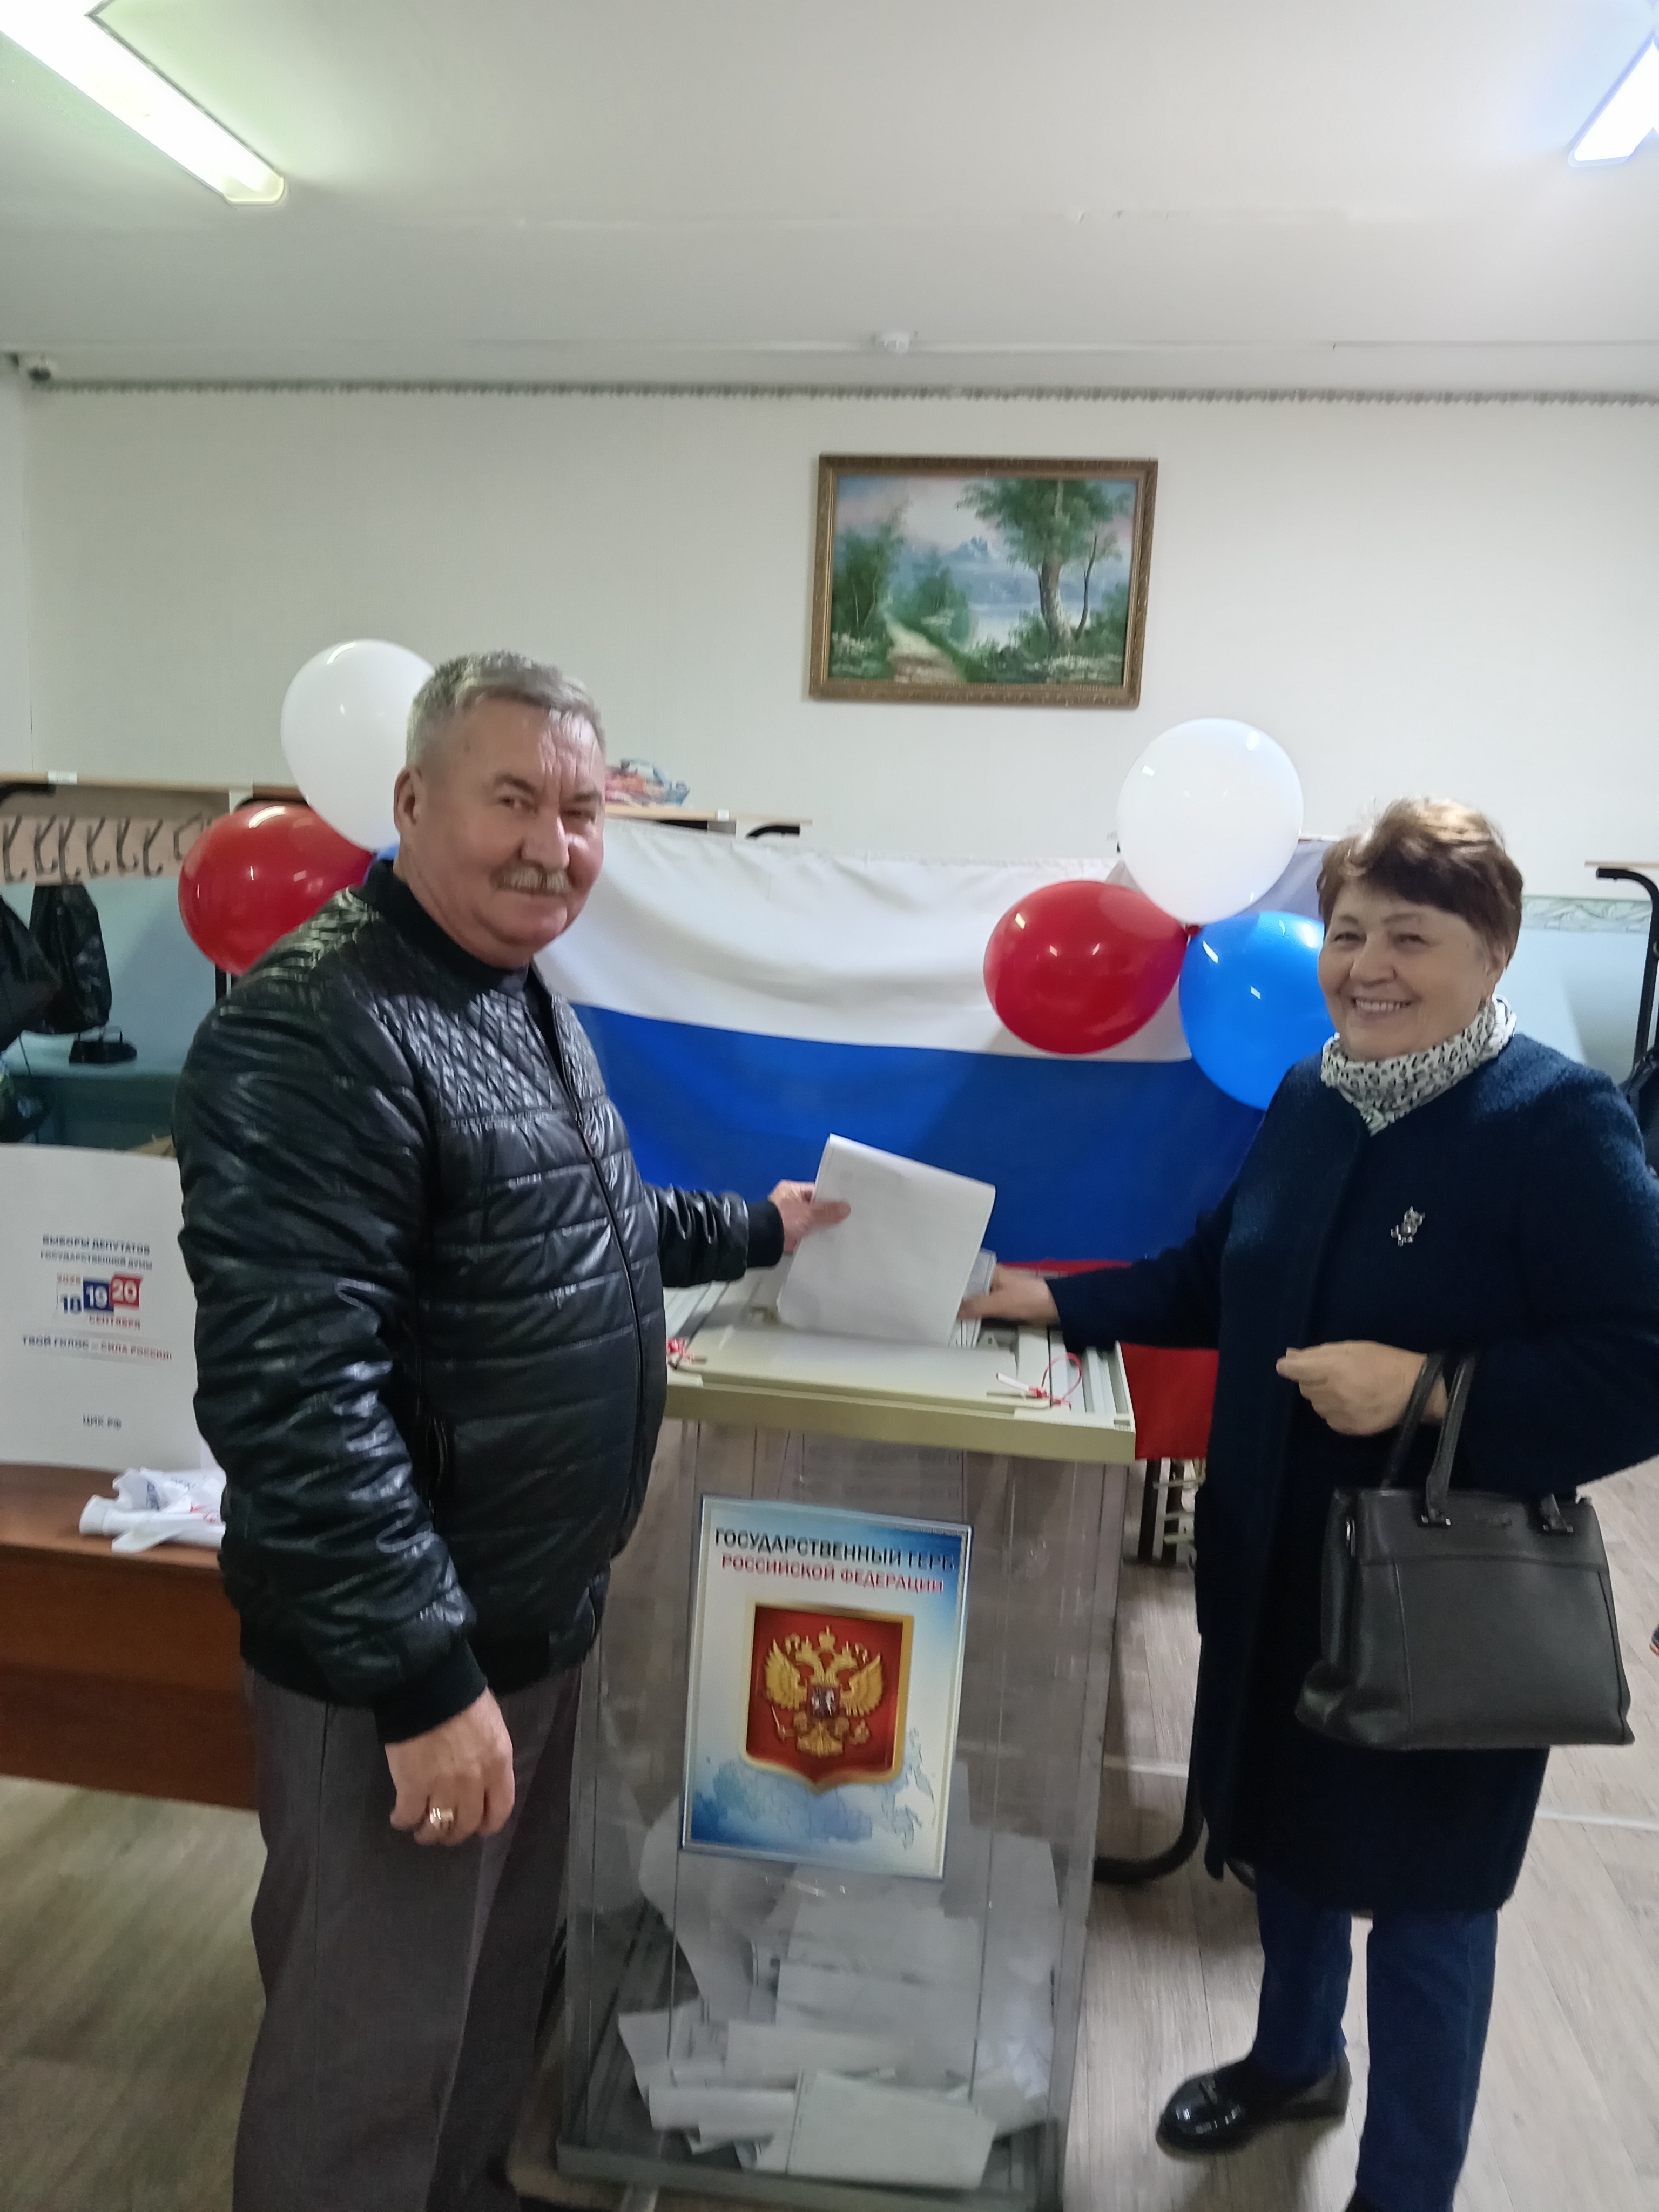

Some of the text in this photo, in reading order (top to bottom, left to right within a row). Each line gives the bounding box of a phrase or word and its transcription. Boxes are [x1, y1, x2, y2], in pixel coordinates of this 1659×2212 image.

[112, 1279, 137, 1304] 20
[716, 1527, 955, 1572] ГОСУДАРСТВЕННЫЙ ГЕРБ
[721, 1552, 943, 1596] РОССИЙСКОЙ ФЕДЕРАЦИИ
